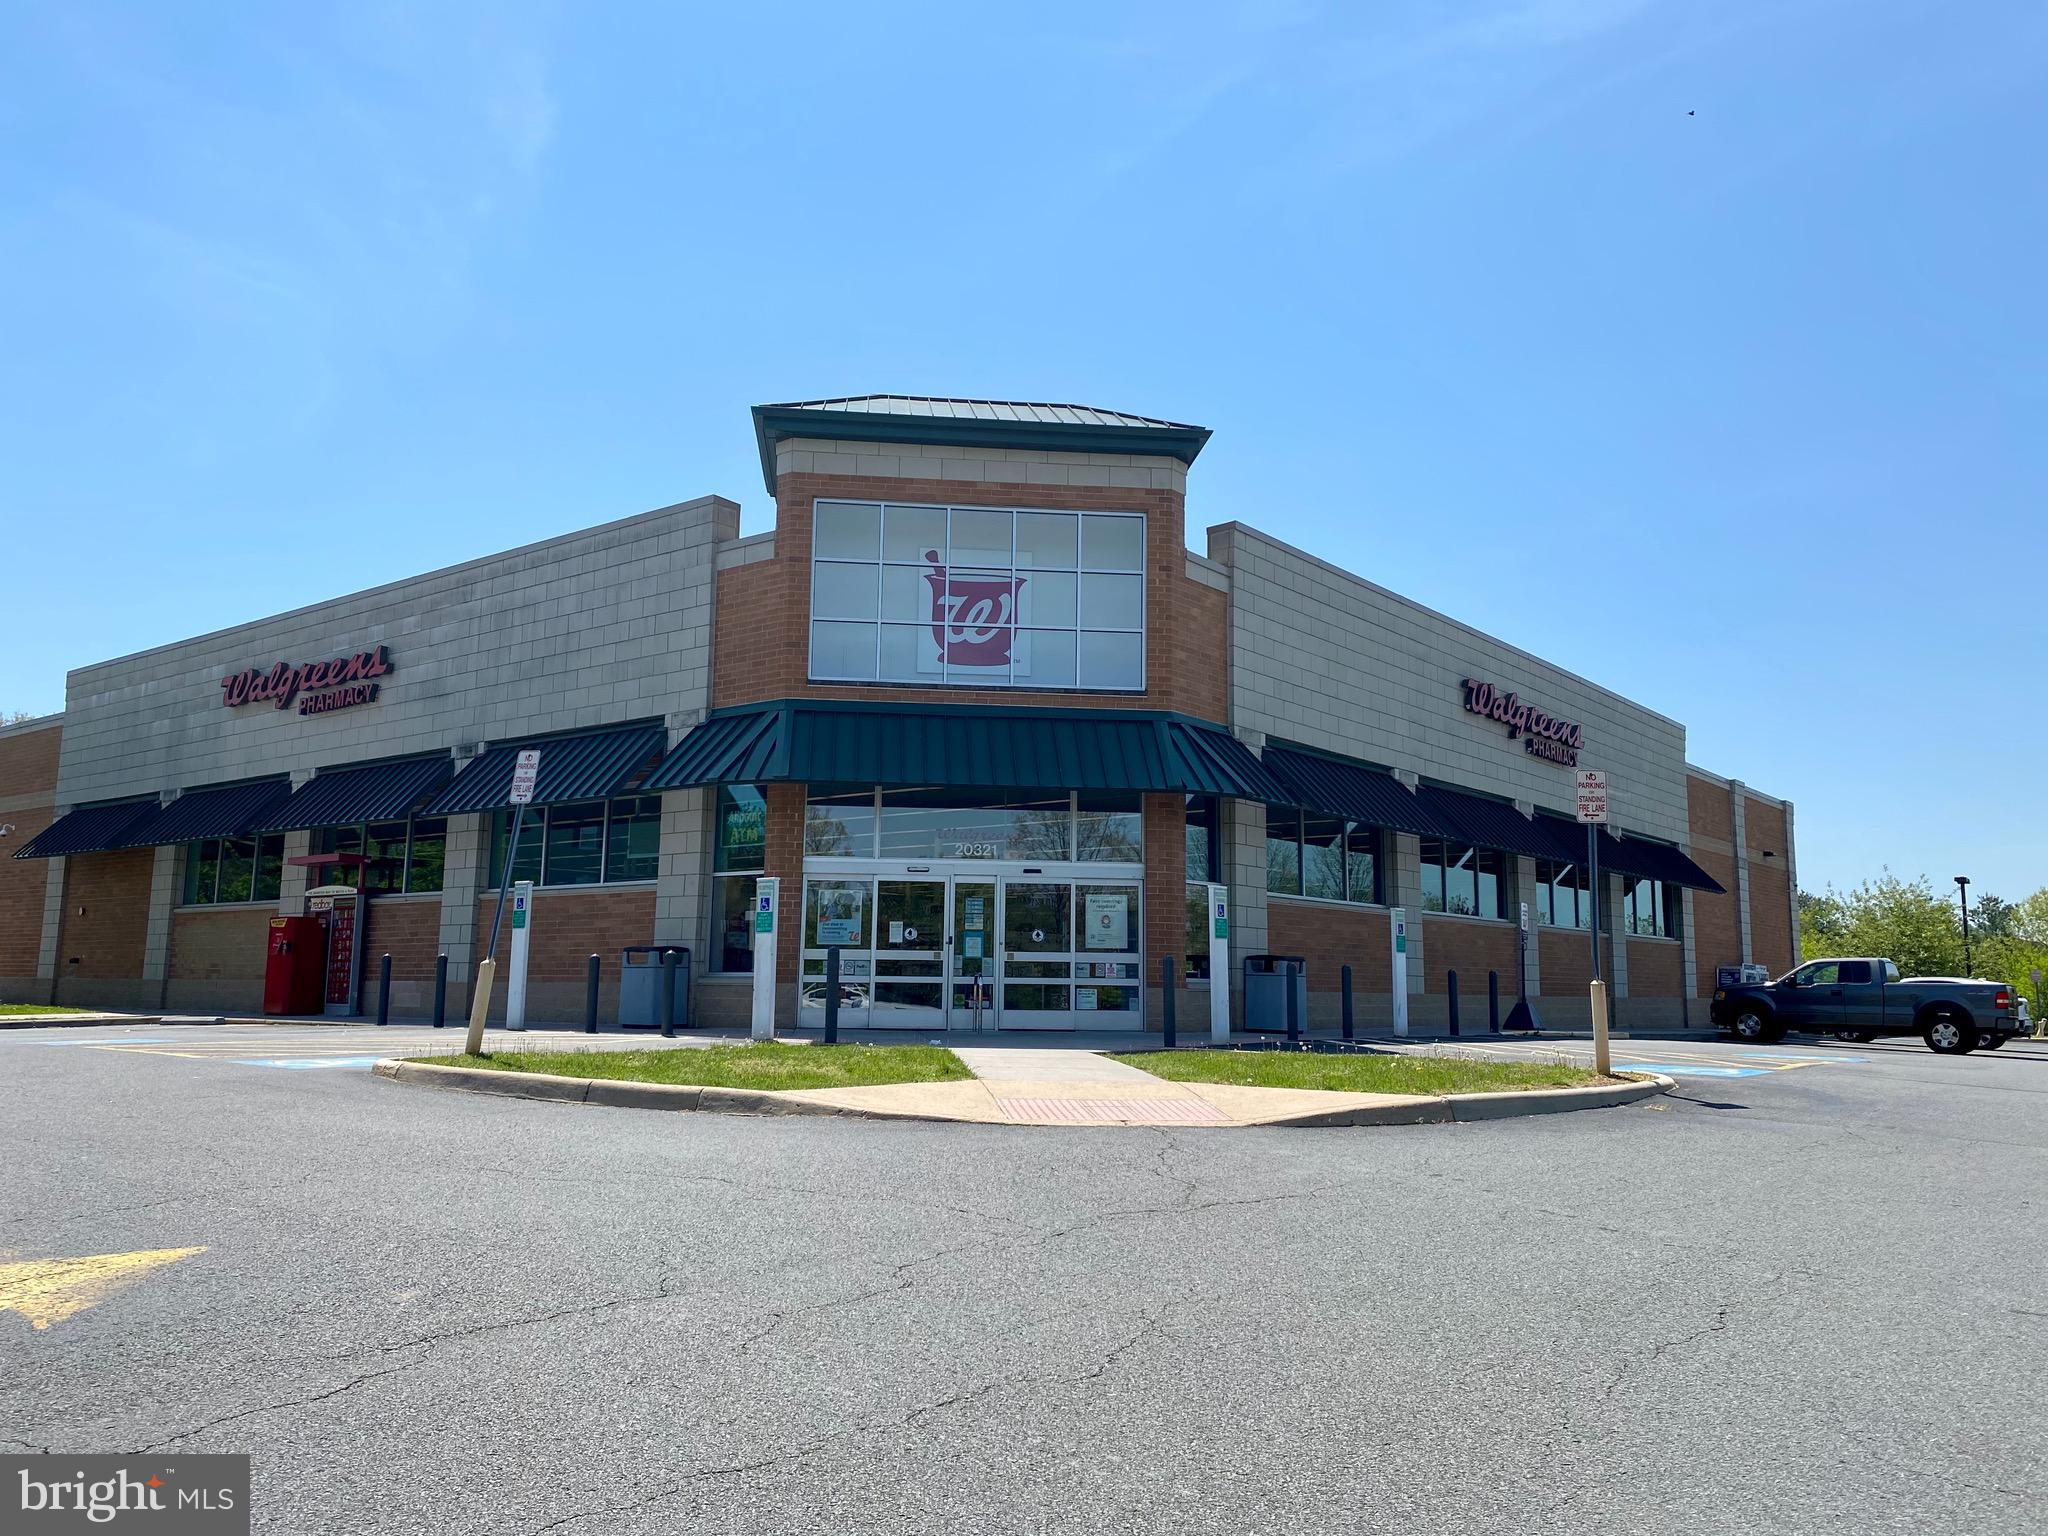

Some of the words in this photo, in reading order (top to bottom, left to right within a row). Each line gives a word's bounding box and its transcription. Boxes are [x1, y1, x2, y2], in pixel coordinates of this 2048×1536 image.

[221, 645, 391, 710] Walgreens
[299, 684, 376, 714] PHARMACY
[1464, 679, 1585, 749] Walgreens
[1579, 795, 1605, 803] STANDING
[1579, 804, 1590, 812] FIRE
[1591, 804, 1605, 812] LANE
[954, 843, 998, 856] 20321
